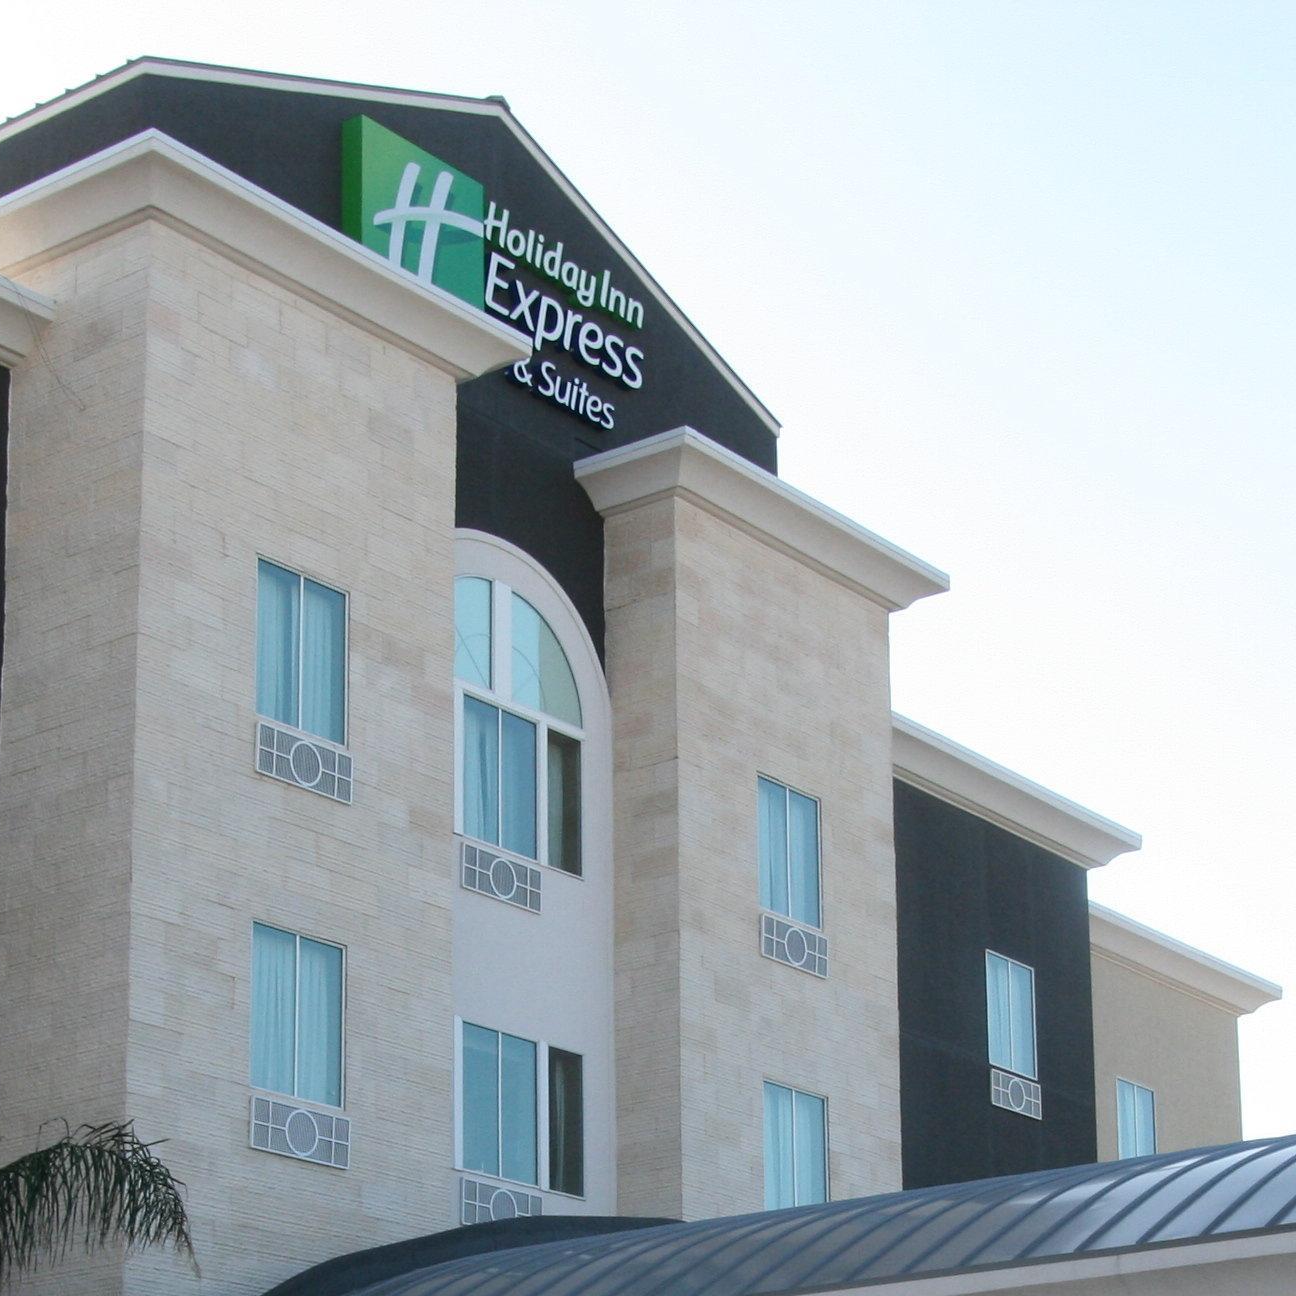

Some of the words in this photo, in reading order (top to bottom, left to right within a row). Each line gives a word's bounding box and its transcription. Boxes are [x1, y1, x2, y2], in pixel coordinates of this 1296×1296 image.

[484, 201, 596, 307] Holiday
[600, 269, 644, 329] Inn
[485, 252, 644, 389] Express
[538, 361, 615, 430] Suites
